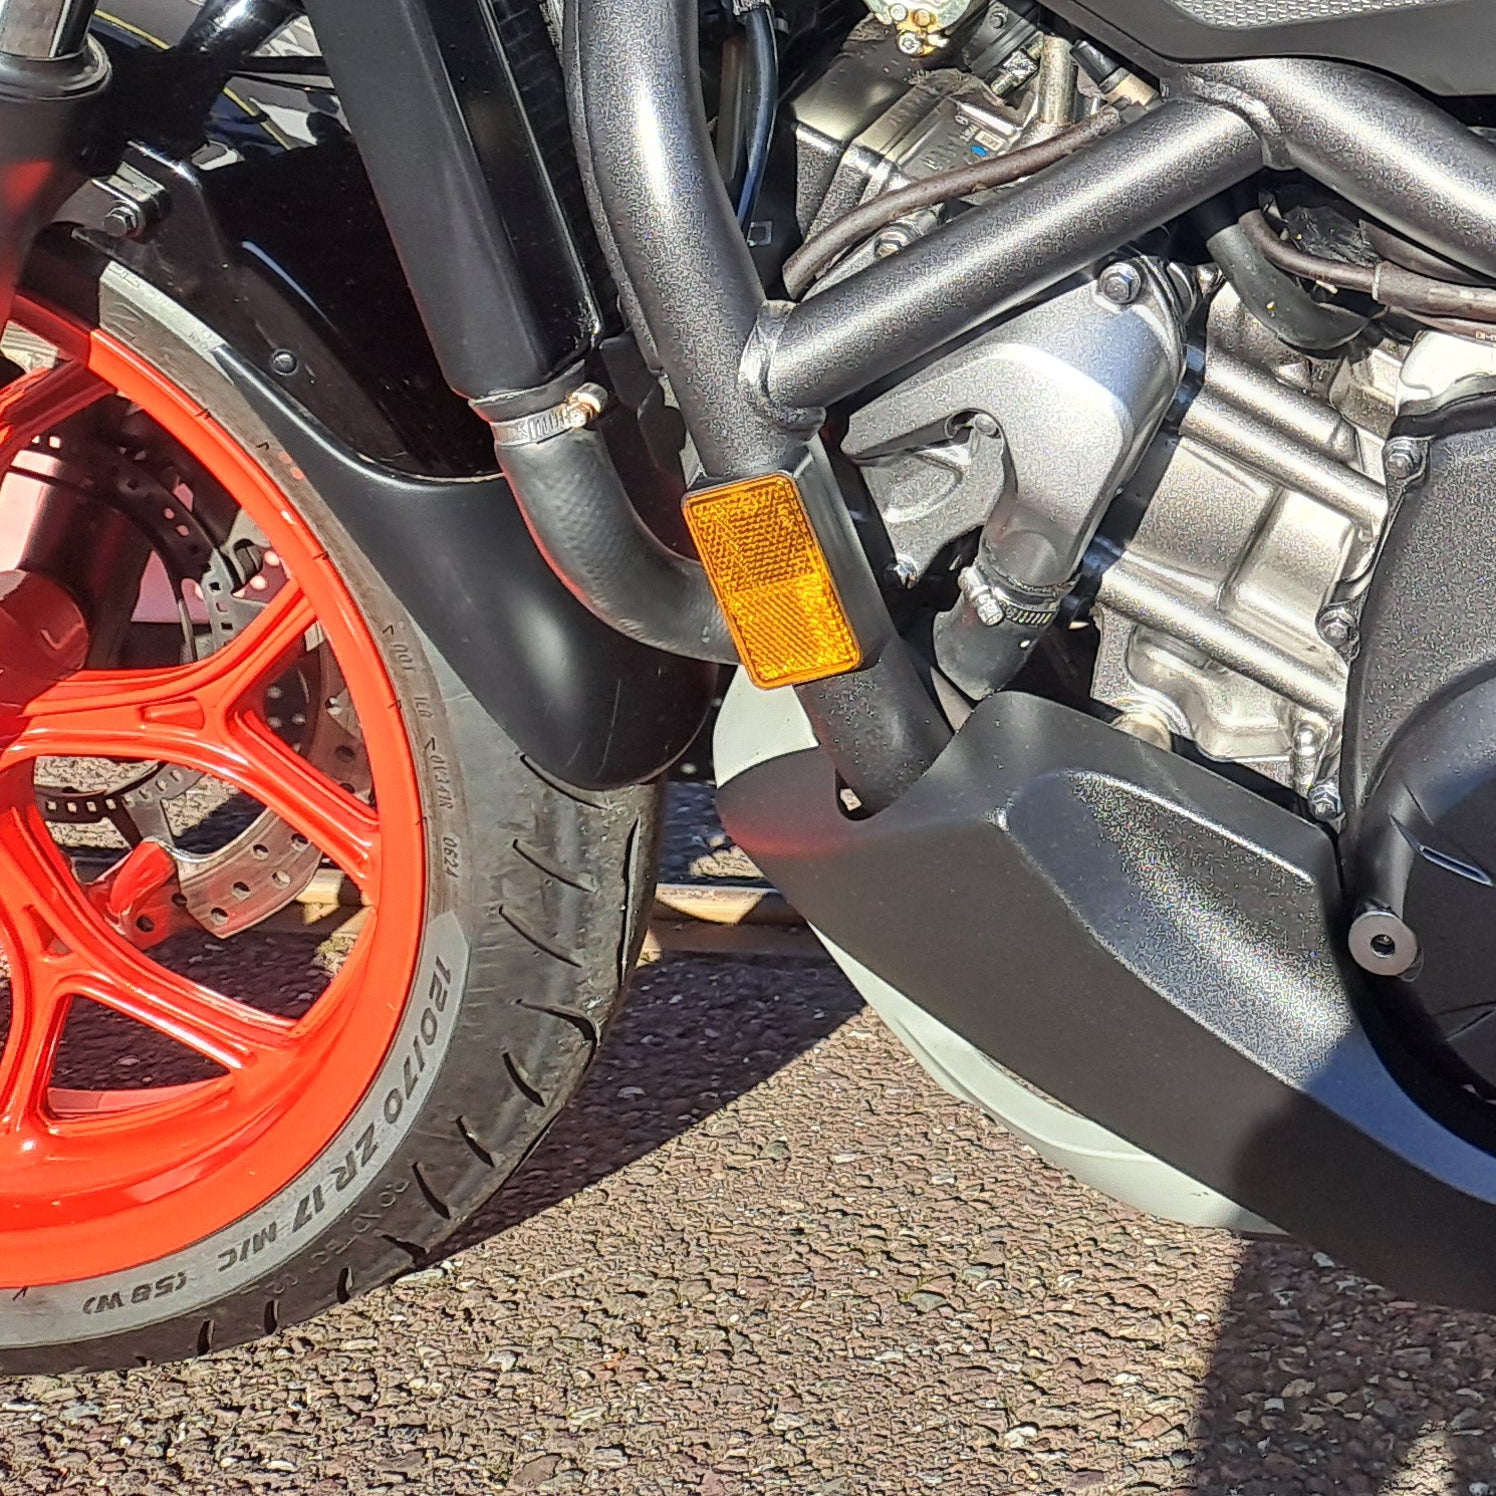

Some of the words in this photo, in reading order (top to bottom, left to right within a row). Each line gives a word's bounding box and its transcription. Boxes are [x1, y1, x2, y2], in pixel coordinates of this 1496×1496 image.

[441, 834, 461, 879] 0624
[329, 1124, 380, 1193] ZR
[291, 1184, 329, 1235] 17
[217, 1221, 277, 1273] M/C
